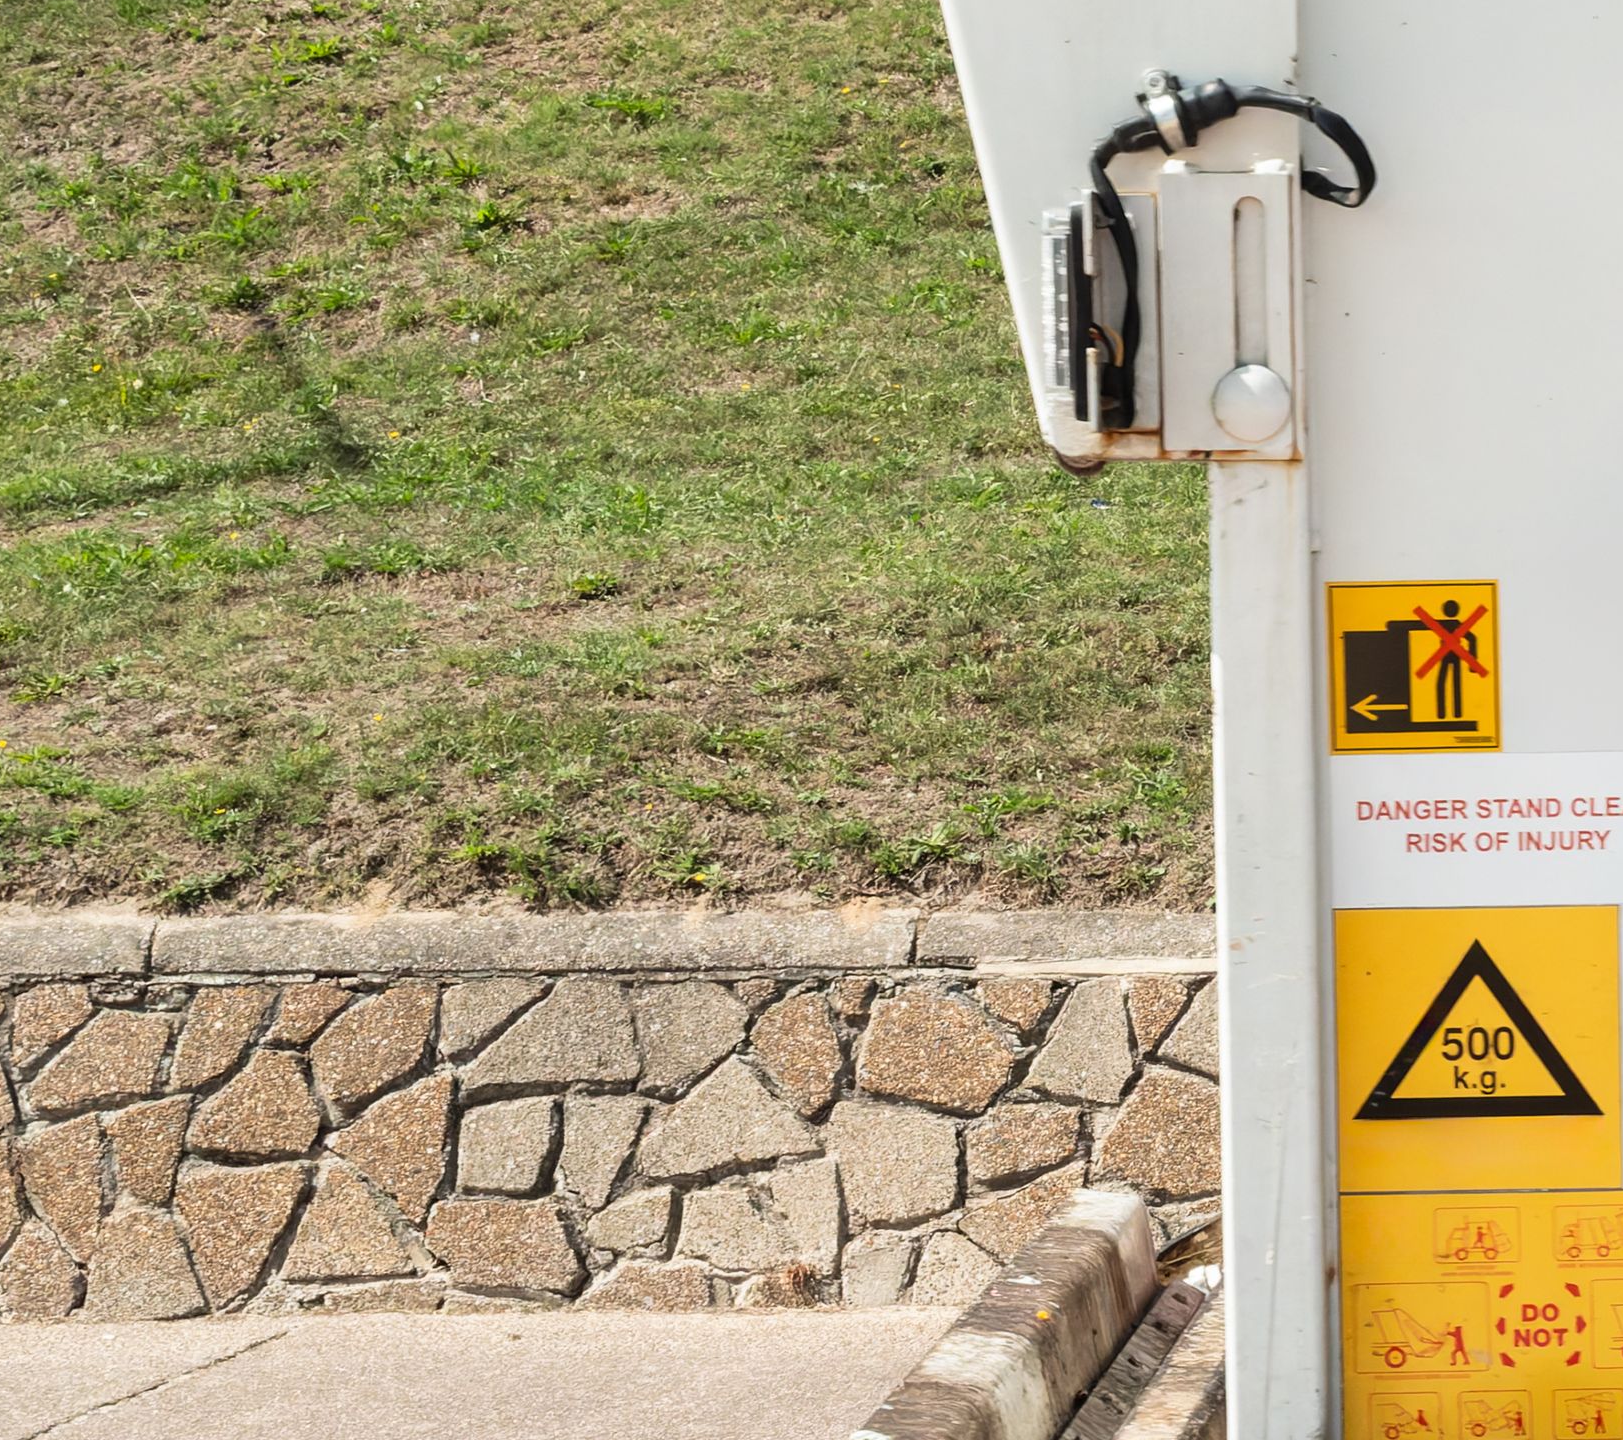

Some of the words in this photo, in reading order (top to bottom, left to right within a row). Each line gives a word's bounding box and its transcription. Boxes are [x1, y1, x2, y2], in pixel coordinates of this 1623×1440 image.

[1356, 798, 1468, 821] DANGER
[1476, 797, 1561, 819] STAND
[1406, 832, 1467, 853] RISK
[1475, 832, 1509, 852] OF
[1518, 830, 1611, 852] INJURY
[1442, 1026, 1515, 1061] 500
[1453, 1066, 1507, 1095] k.g.
[1521, 1303, 1559, 1323] DO
[1513, 1327, 1569, 1348] NOT
